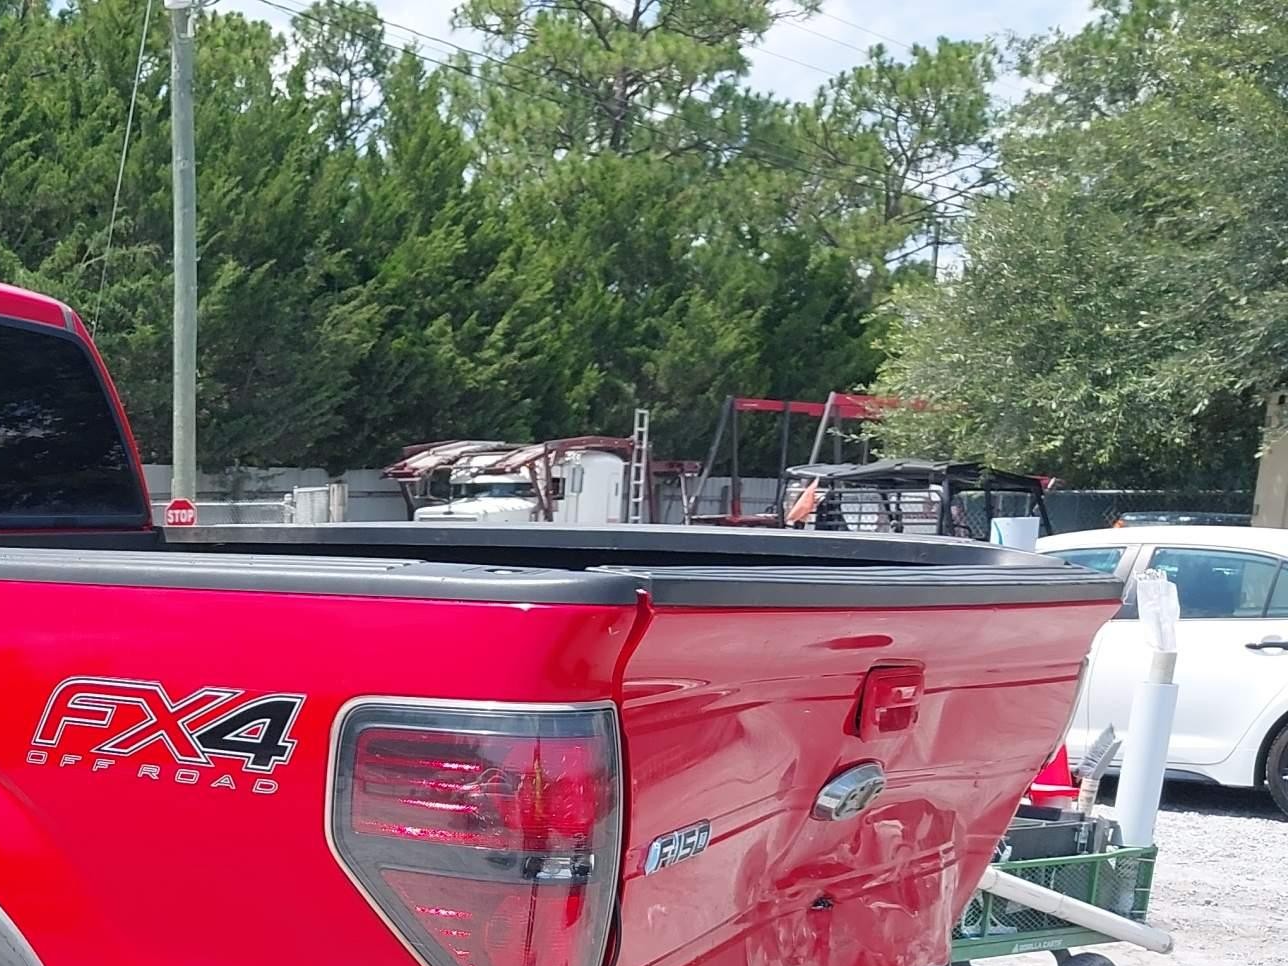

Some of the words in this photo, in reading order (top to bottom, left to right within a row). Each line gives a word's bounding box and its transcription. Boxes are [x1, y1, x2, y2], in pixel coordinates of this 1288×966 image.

[167, 509, 194, 523] STOP
[32, 675, 308, 775] FX4
[26, 750, 115, 772] OFF
[137, 764, 279, 794] ROAD
